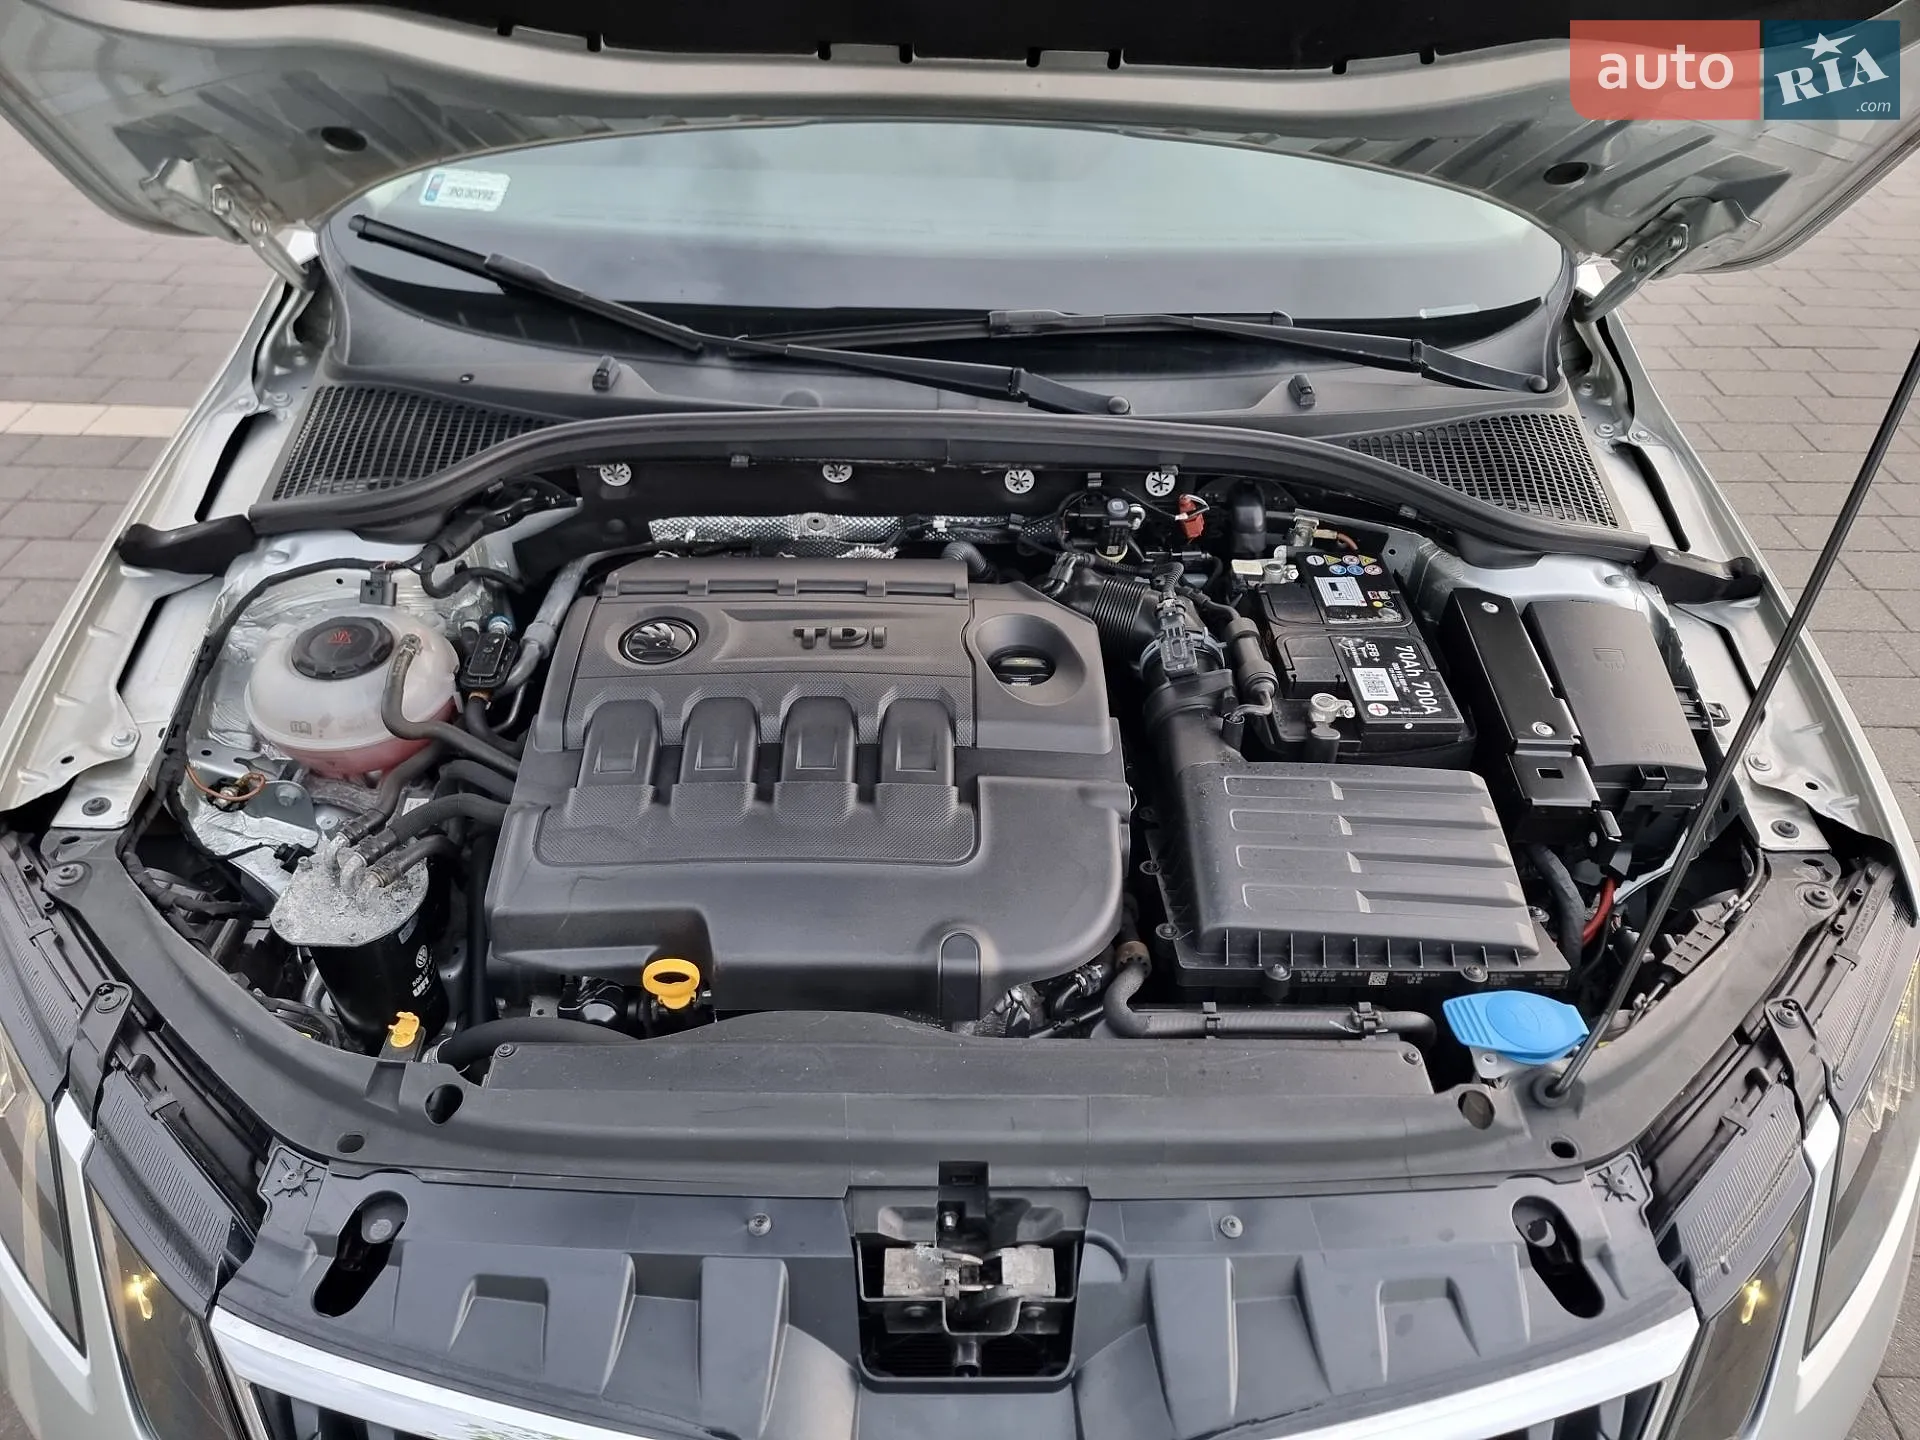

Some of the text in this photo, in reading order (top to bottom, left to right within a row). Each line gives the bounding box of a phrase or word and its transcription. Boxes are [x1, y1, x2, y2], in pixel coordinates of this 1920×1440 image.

[793, 626, 888, 650] TDI
[1395, 645, 1442, 715] 70Ah 700A
